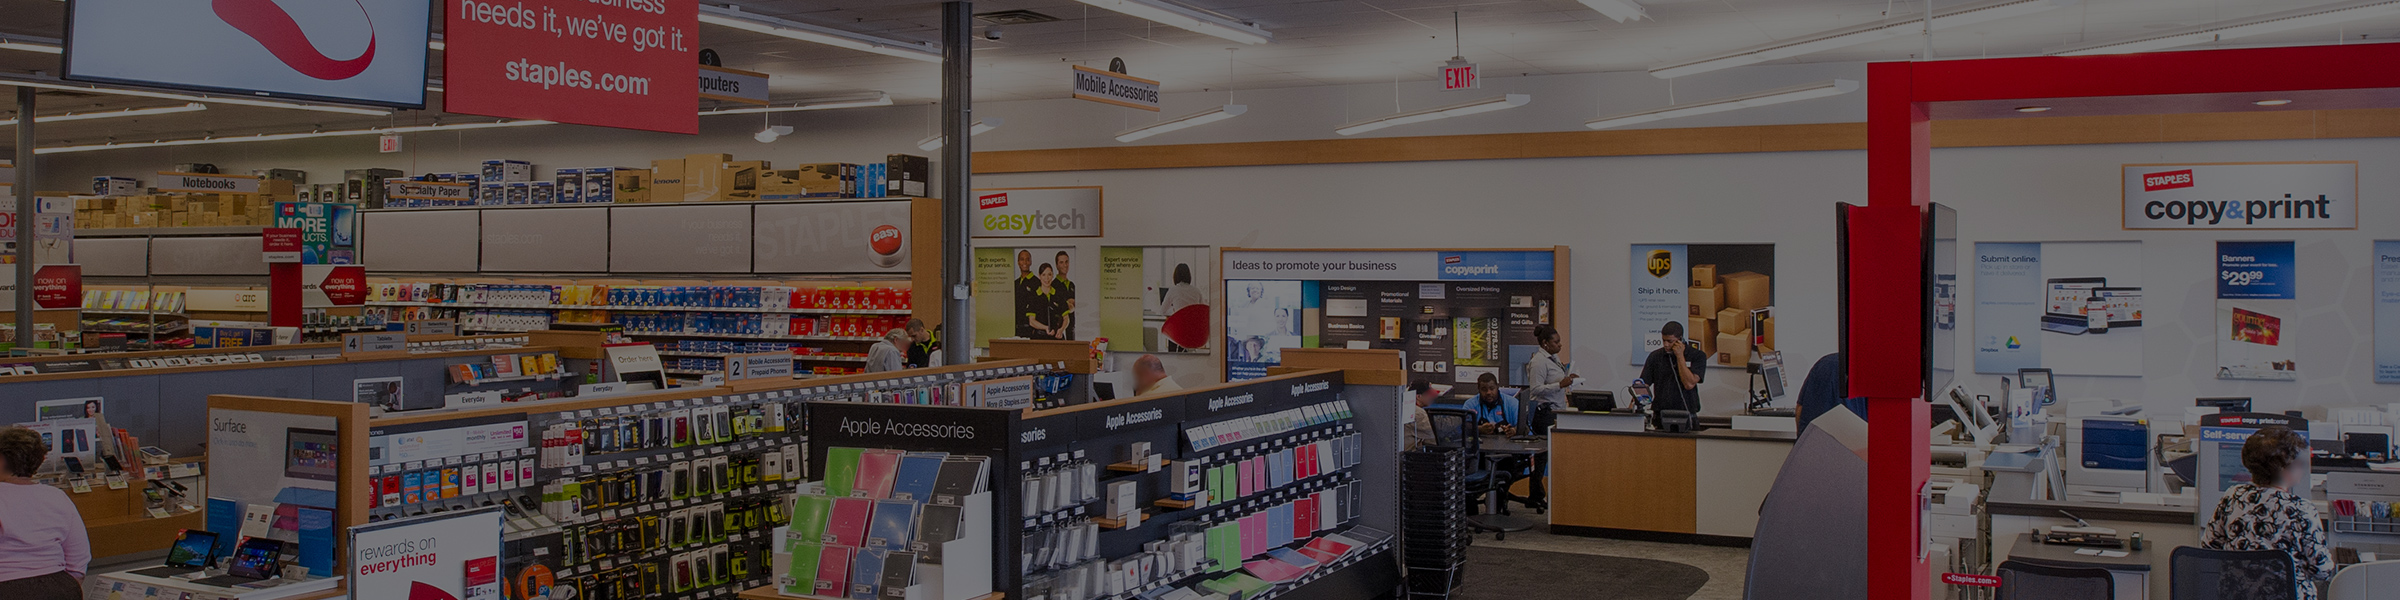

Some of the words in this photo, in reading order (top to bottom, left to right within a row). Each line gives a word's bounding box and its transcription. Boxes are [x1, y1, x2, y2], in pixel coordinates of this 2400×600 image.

[462, 0, 536, 29] needs
[543, 6, 562, 38] it,
[566, 14, 627, 43] we've
[633, 26, 666, 52] got
[671, 26, 688, 52] it.
[706, 52, 712, 66] 3
[1116, 60, 1120, 74] 2
[506, 58, 648, 96] staples.com
[1446, 66, 1472, 89] EXIT
[1076, 73, 1106, 94] Mobile
[1108, 79, 1158, 104] Accessories
[206, 166, 212, 174] 7
[182, 177, 236, 190] Notebooks
[2146, 174, 2191, 186] STAPLES
[439, 186, 460, 197] Paper
[981, 196, 1006, 206] STAPLES
[2144, 194, 2330, 225] copy&print
[278, 217, 326, 232] MORE
[984, 208, 1086, 234] easytech
[873, 228, 898, 242] easy
[1232, 260, 1260, 270] Ideas
[1263, 261, 1273, 270] to
[1276, 261, 1320, 272] promote
[1322, 262, 1346, 272] your
[1349, 260, 1397, 270] business
[1445, 264, 1498, 276] copy&print
[1649, 258, 1670, 274] ups
[242, 294, 256, 302] arc
[410, 323, 416, 332] 5
[220, 338, 243, 347] FREE
[349, 338, 356, 349] 4
[733, 361, 740, 376] 2
[971, 390, 977, 406] 1
[987, 387, 1001, 395] Apple
[1002, 384, 1030, 393] Accessories
[1291, 384, 1304, 397] Apple
[1305, 380, 1329, 392] Accessories
[1004, 398, 1029, 408] Staples.com
[1208, 397, 1224, 412] Apple
[1224, 392, 1253, 407] Accessories
[214, 418, 246, 433] Surface
[1106, 414, 1125, 430] Apple
[1126, 408, 1162, 425] Accessories
[840, 416, 880, 437] Apple
[884, 418, 974, 439] Accessories
[360, 538, 415, 561] rewards
[419, 536, 436, 549] on
[360, 552, 436, 576] everything
[1951, 575, 1992, 584] Staples.com
